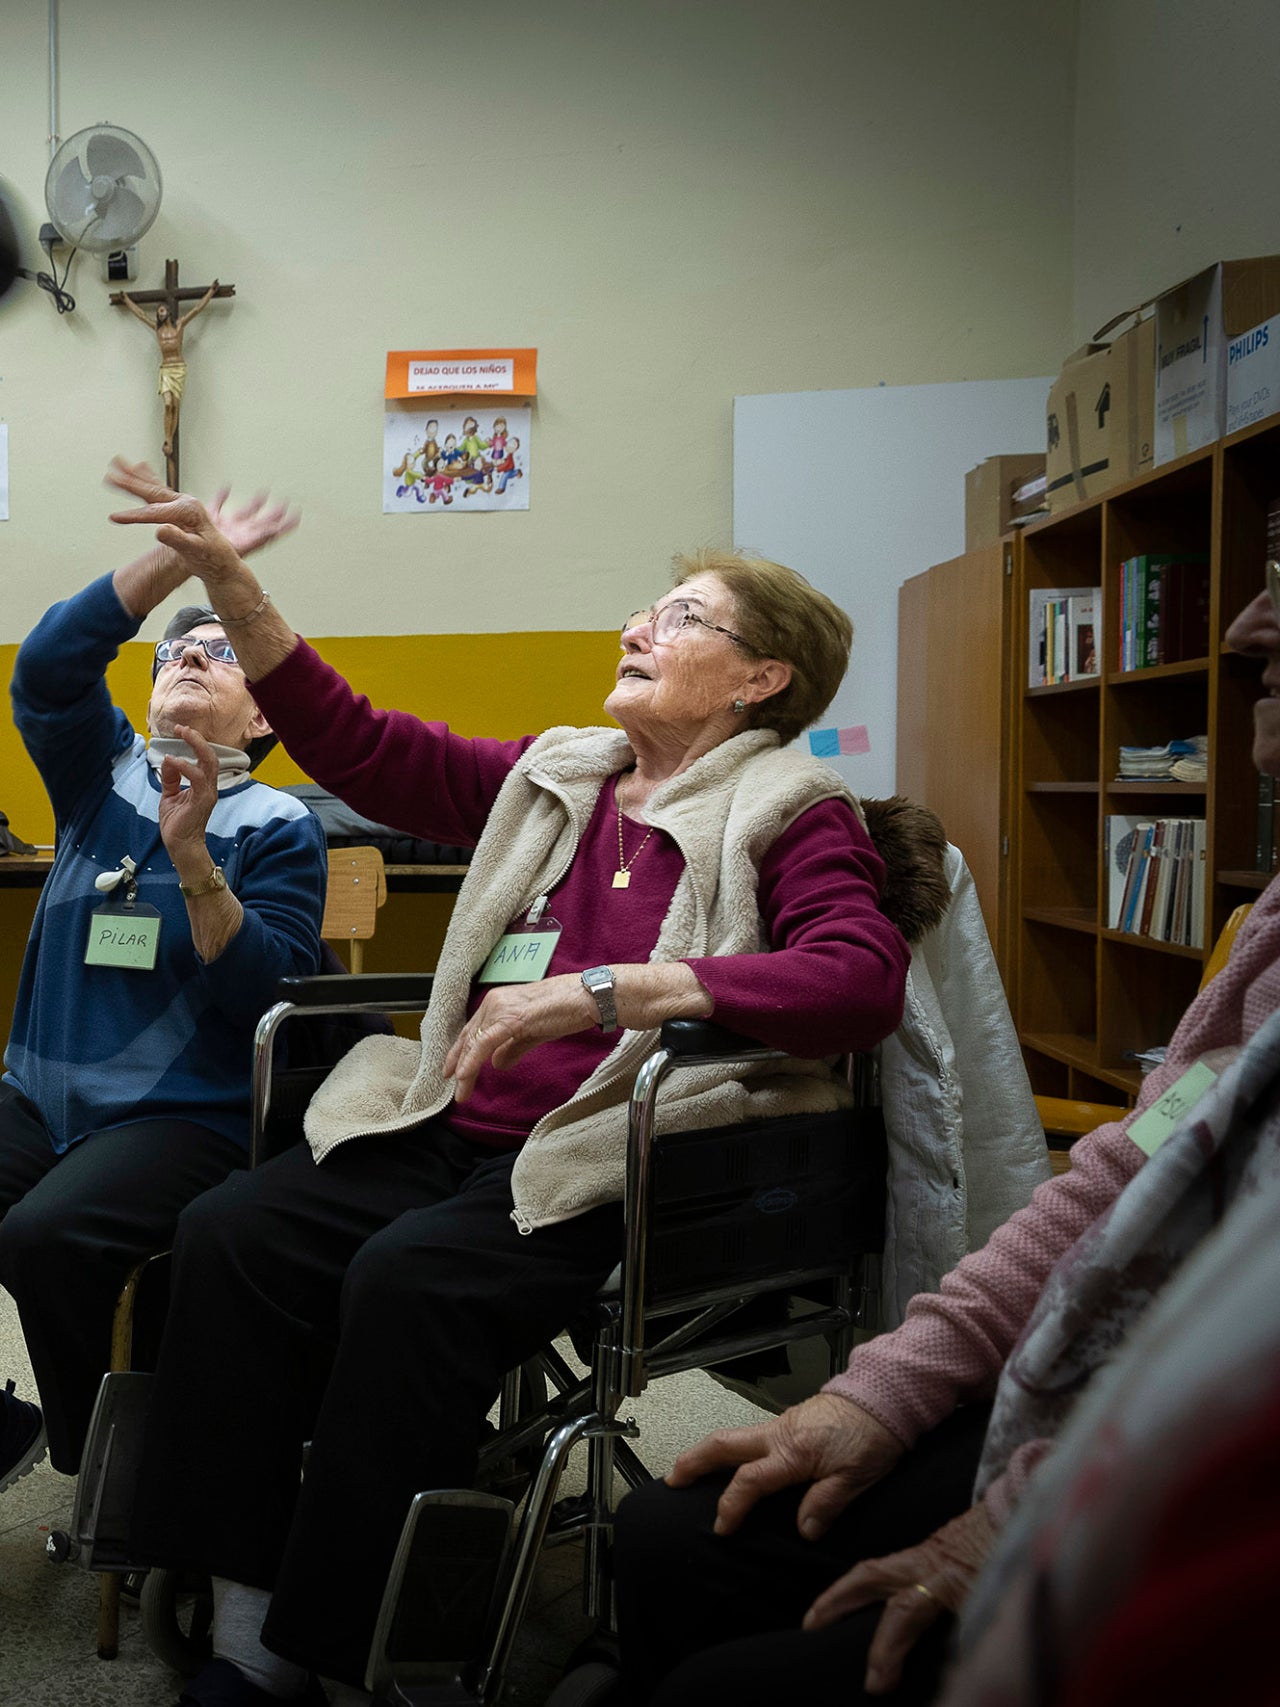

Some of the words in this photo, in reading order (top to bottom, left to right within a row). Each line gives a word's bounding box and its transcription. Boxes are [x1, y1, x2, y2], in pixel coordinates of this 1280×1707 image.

[1229, 325, 1269, 366] PHILIPS
[414, 367, 440, 375] DEJAD
[442, 367, 459, 375] QUE
[462, 366, 477, 374] LOS
[479, 364, 506, 374] NIÑOS
[98, 926, 147, 948] PILAR
[493, 941, 542, 964] ANA
